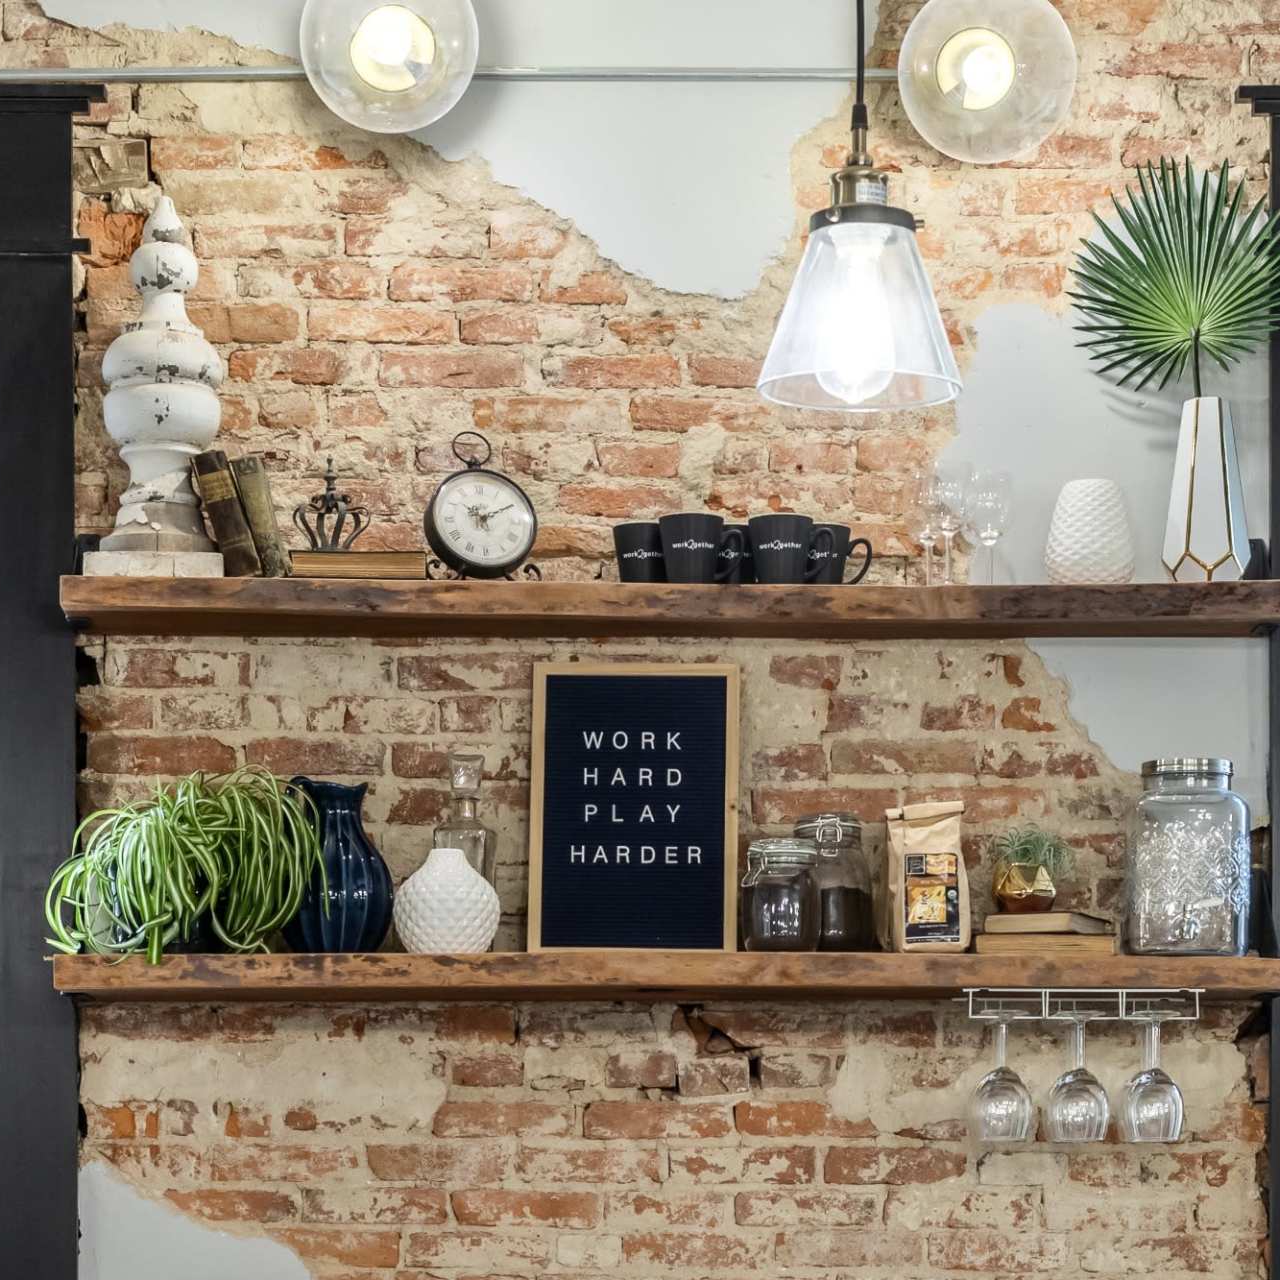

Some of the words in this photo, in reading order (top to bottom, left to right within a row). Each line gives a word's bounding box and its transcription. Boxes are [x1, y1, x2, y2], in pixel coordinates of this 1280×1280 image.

[672, 539, 714, 550] work2gether
[759, 539, 802, 551] work2gether
[583, 731, 682, 750] WORK
[583, 767, 682, 787] HARD
[584, 804, 681, 823] PLAY
[570, 845, 702, 865] HARDER
